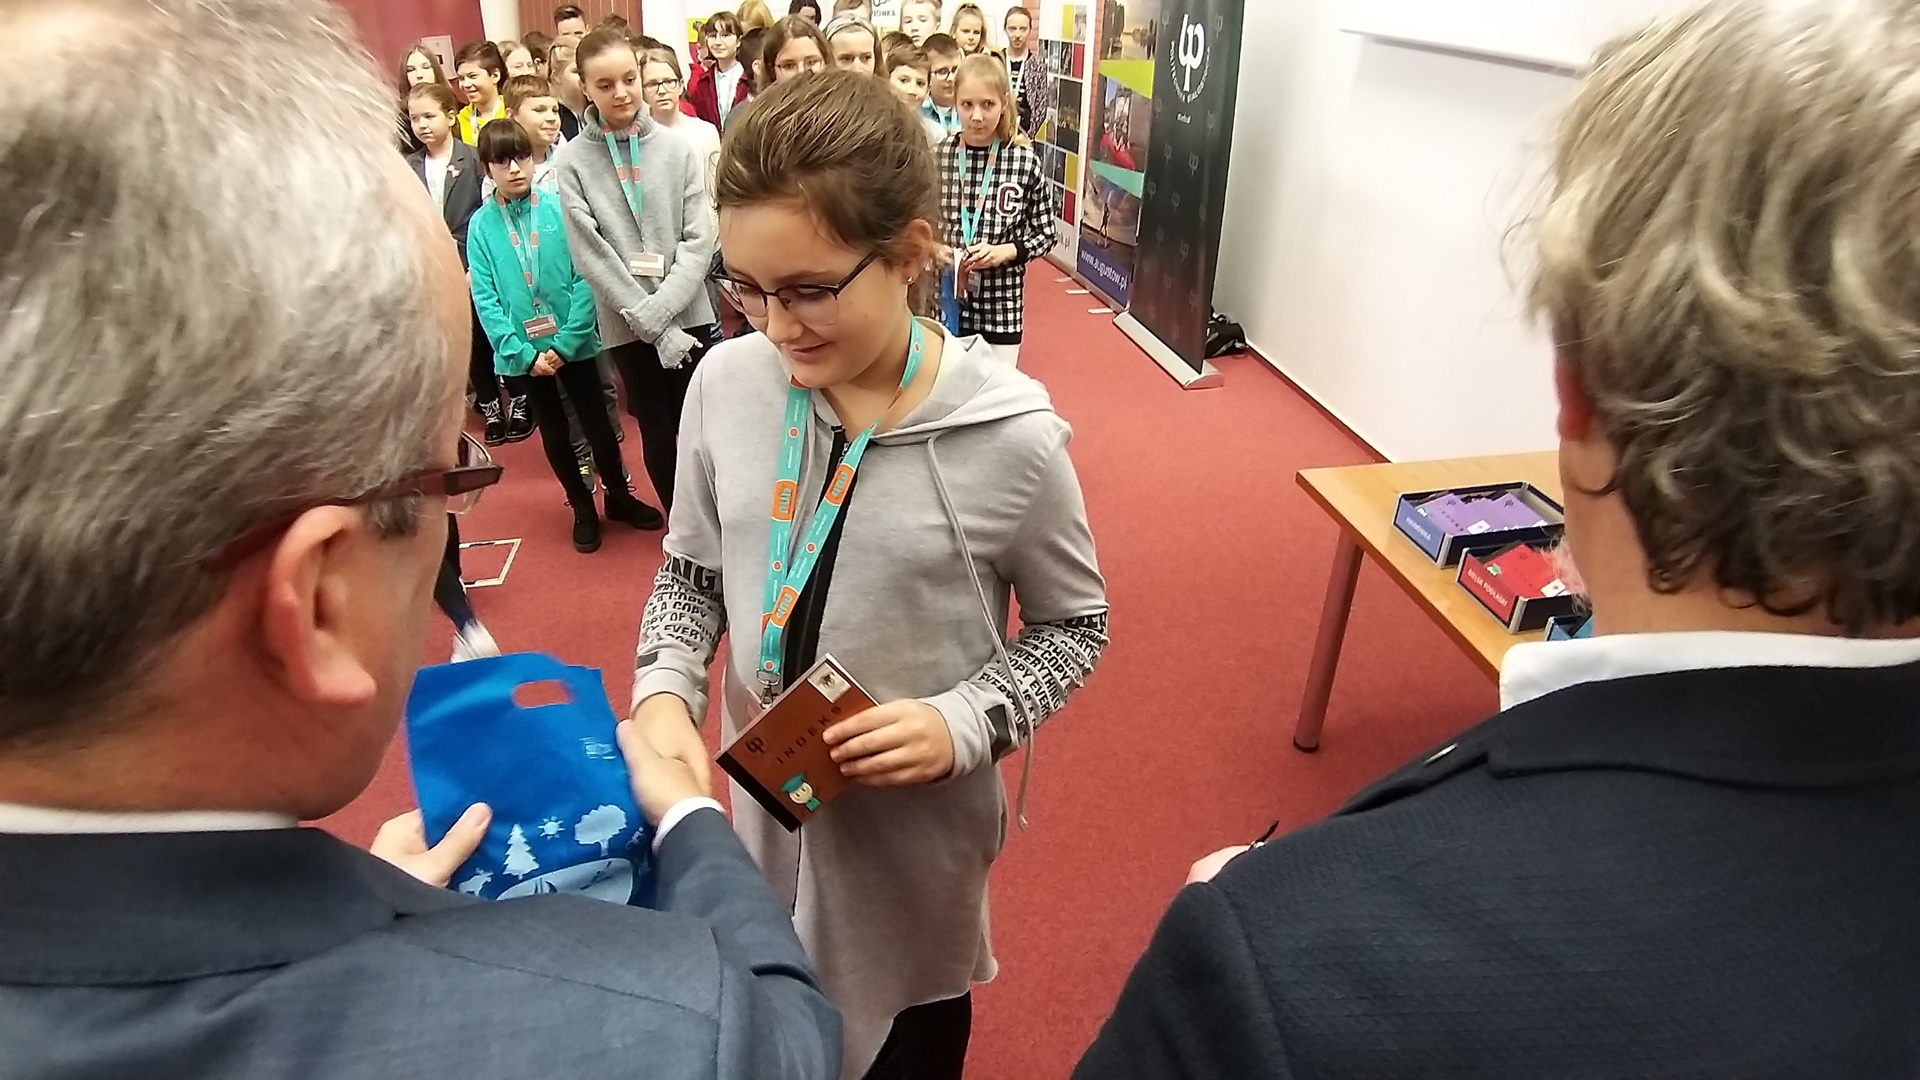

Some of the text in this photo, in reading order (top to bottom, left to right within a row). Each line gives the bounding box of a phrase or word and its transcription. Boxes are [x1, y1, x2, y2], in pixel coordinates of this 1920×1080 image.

[996, 182, 1023, 217] C
[669, 612, 687, 622] OF
[1040, 649, 1071, 684] COPY
